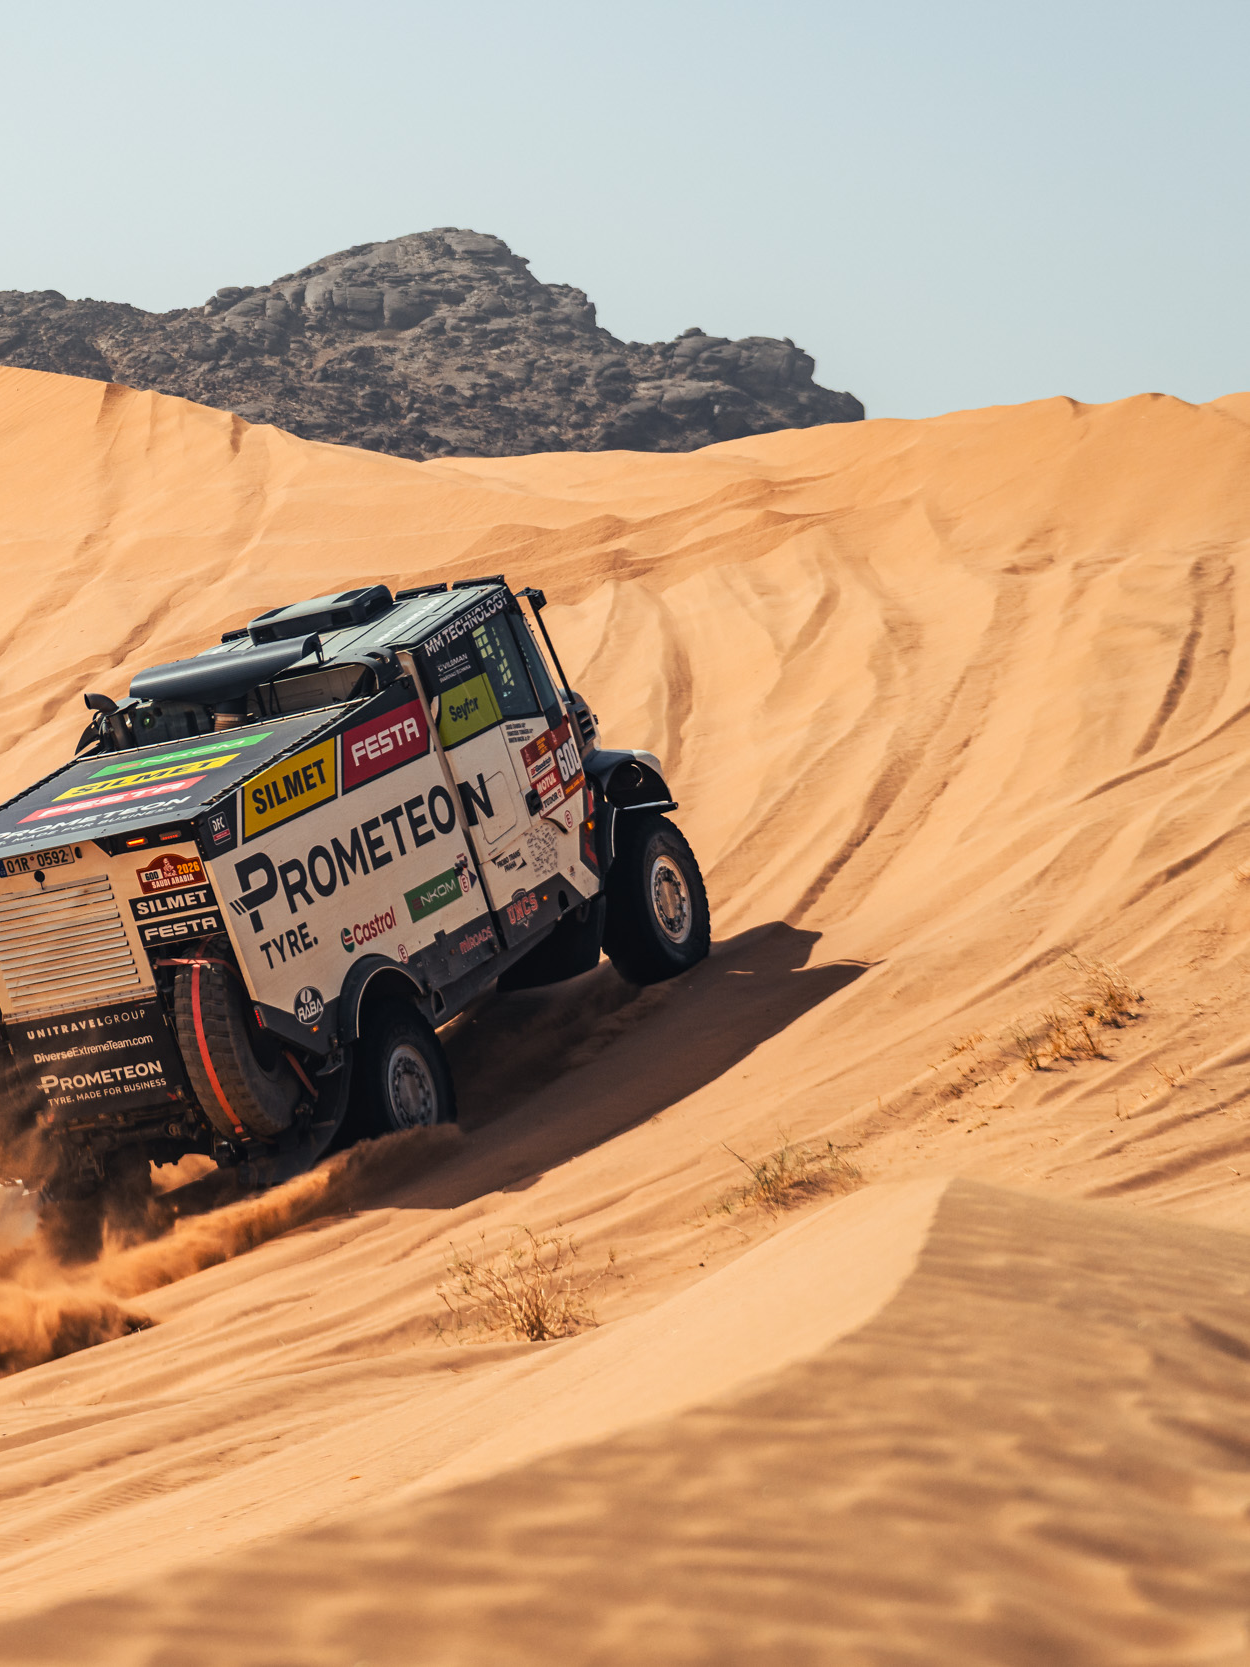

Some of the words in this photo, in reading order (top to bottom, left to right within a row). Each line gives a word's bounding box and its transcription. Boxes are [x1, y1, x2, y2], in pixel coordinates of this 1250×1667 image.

[423, 634, 445, 657] MM
[442, 591, 508, 645] TECHNOLOGY
[351, 717, 420, 767] FESTA
[556, 738, 581, 782] 600
[71, 759, 218, 796] SILMET
[251, 759, 326, 815] SILMET
[536, 772, 557, 794] MOTUL
[38, 781, 187, 817] FESTA
[543, 791, 558, 808] TUDOR
[212, 816, 225, 831] DFC
[7, 858, 30, 873] 01R
[37, 850, 68, 867] 0592
[177, 861, 200, 875] 2026
[229, 773, 494, 933] PROMETEON
[145, 871, 159, 881] 600
[152, 879, 170, 889] SAUDI
[171, 873, 194, 885] ARABIA
[136, 890, 207, 915] SILMET
[507, 892, 538, 925] UNCS
[144, 917, 217, 940] FESTA
[352, 905, 397, 946] Castrol
[260, 922, 319, 969] TYRE.
[297, 998, 324, 1022] RABA
[33, 1034, 153, 1064] DiverseExtremeTeam.com
[37, 1060, 163, 1094] PROMETEON
[48, 1095, 75, 1107] TYRE.
[76, 1090, 101, 1101] MADE
[104, 1086, 122, 1097] FOR
[123, 1078, 167, 1093] BUSINESS
